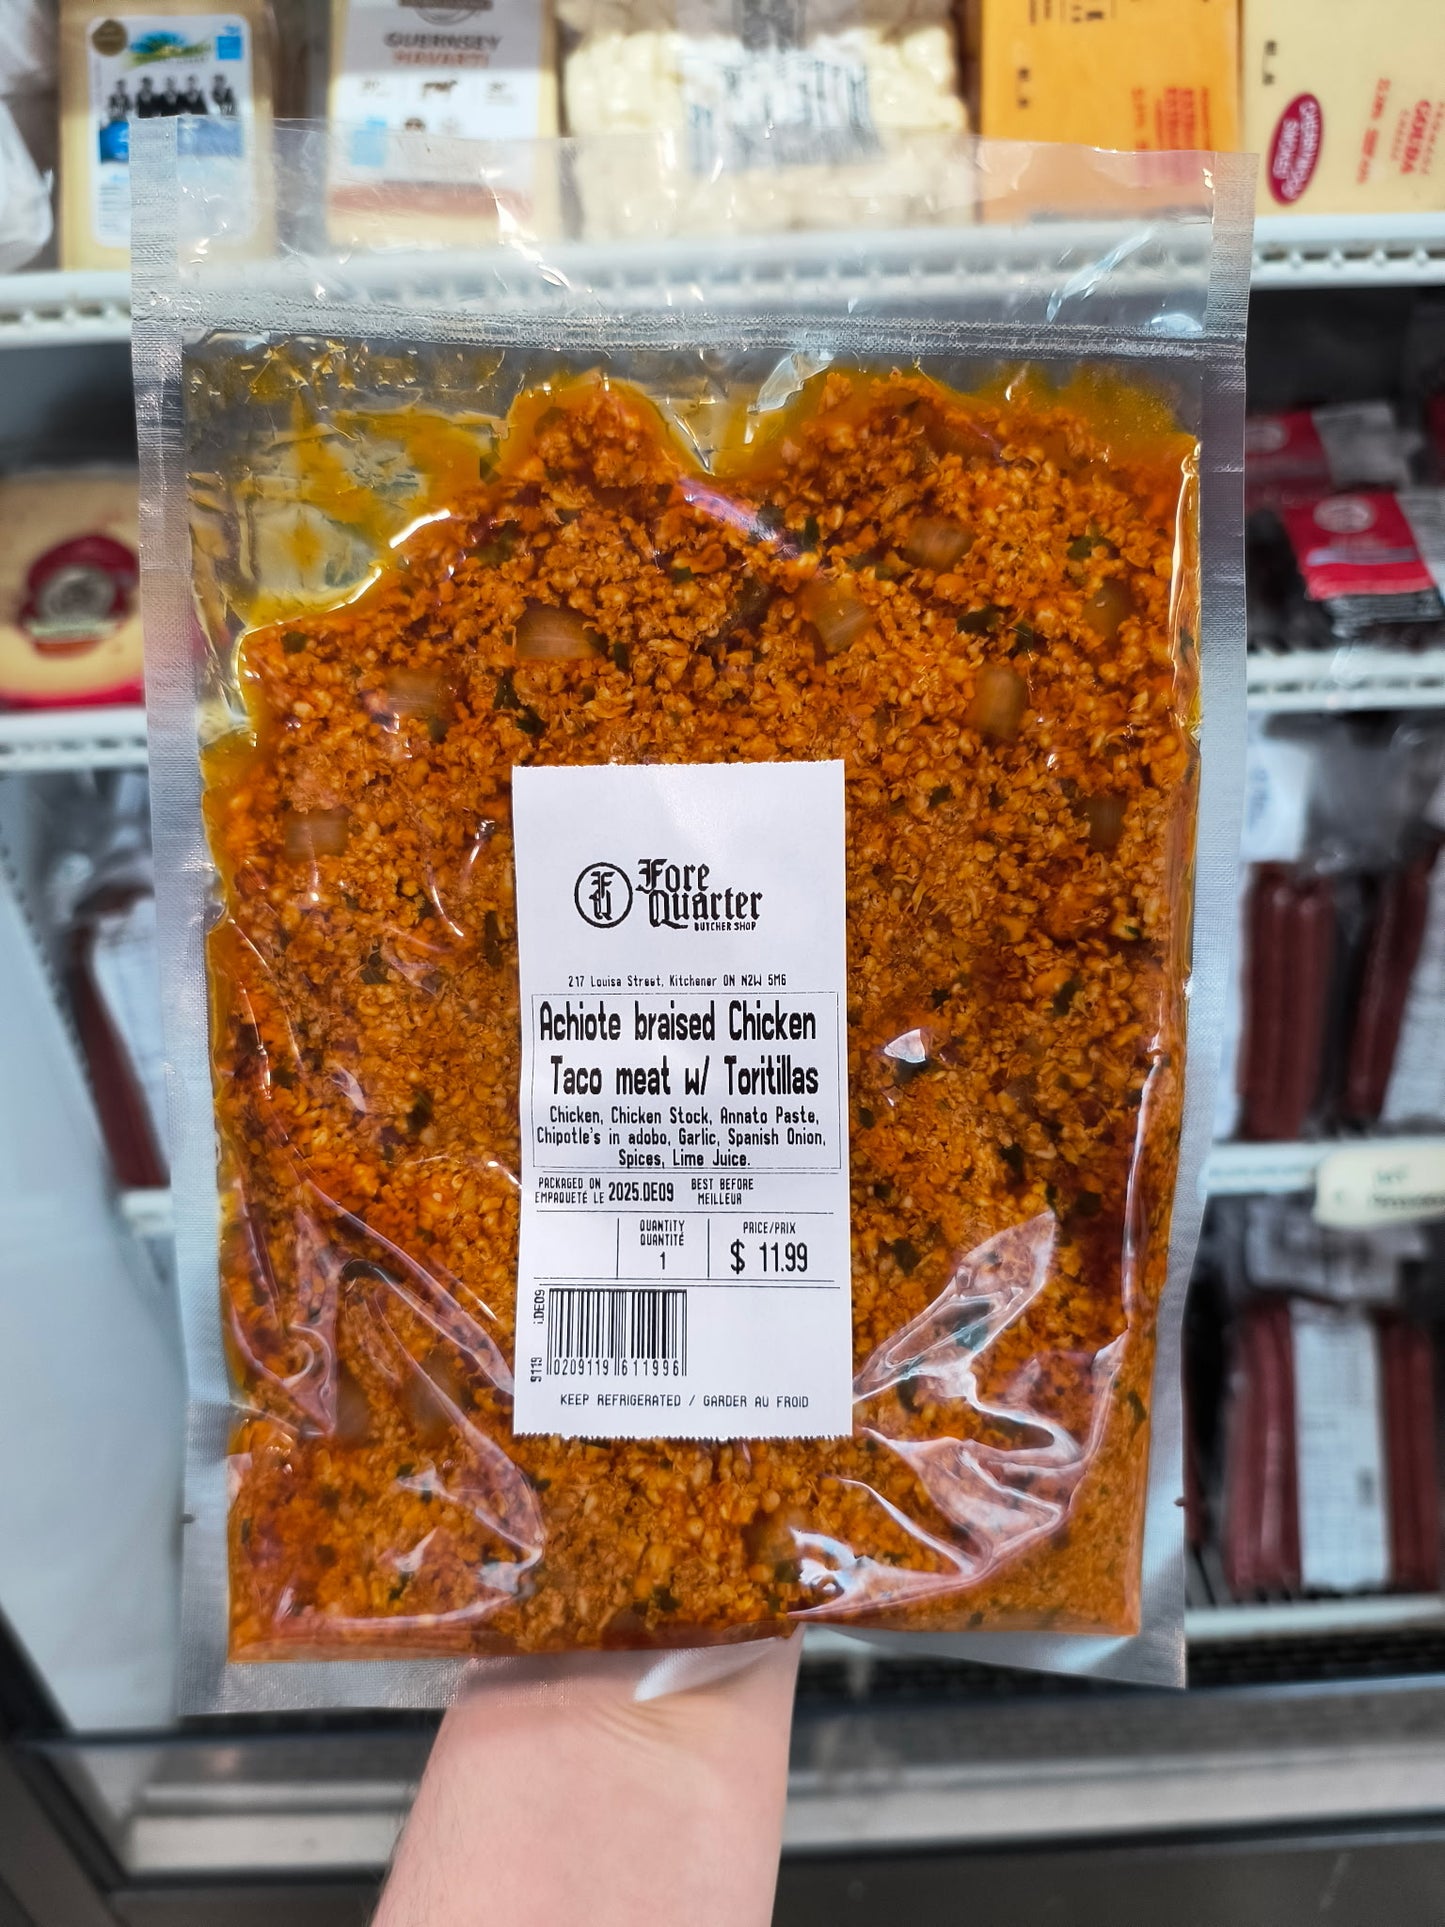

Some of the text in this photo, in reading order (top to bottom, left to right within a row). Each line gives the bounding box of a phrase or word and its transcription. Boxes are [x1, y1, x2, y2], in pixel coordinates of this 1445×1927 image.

[635, 859, 709, 892] Fore
[648, 889, 763, 930] Quarter
[694, 921, 756, 931] BUTCHER SHOP
[569, 974, 786, 987] 217 Louisa Street, Kitchener ON N2W 5M6
[540, 1000, 816, 1041] Achiote braised Chicken
[551, 1055, 818, 1095] Taco meat w/ Toritillas
[550, 1106, 819, 1125] Chicken, Chicken Stock, Annato Paste,
[537, 1126, 825, 1147] Chipotle's in adobo, Garlic, Spanish Onion,
[619, 1149, 750, 1168] Spices, Lime Juice.
[539, 1177, 600, 1189] PACKAGED ON
[609, 1182, 674, 1202] 2025.DE09
[691, 1178, 754, 1190] BEST BEFORE
[535, 1191, 604, 1204] EMPAQUETÉ LE
[698, 1193, 741, 1205] MEILLEUR
[640, 1219, 685, 1232] QUANTITY
[743, 1222, 795, 1234] PRICE/PRIX
[641, 1233, 684, 1246] QUANTITÉ
[660, 1252, 665, 1270] 1
[731, 1239, 807, 1275] $ 11.99
[554, 1358, 678, 1376] 0209119 611996
[561, 1394, 808, 1408] KEEP REFRIGERATED / GARDER AU FROID
